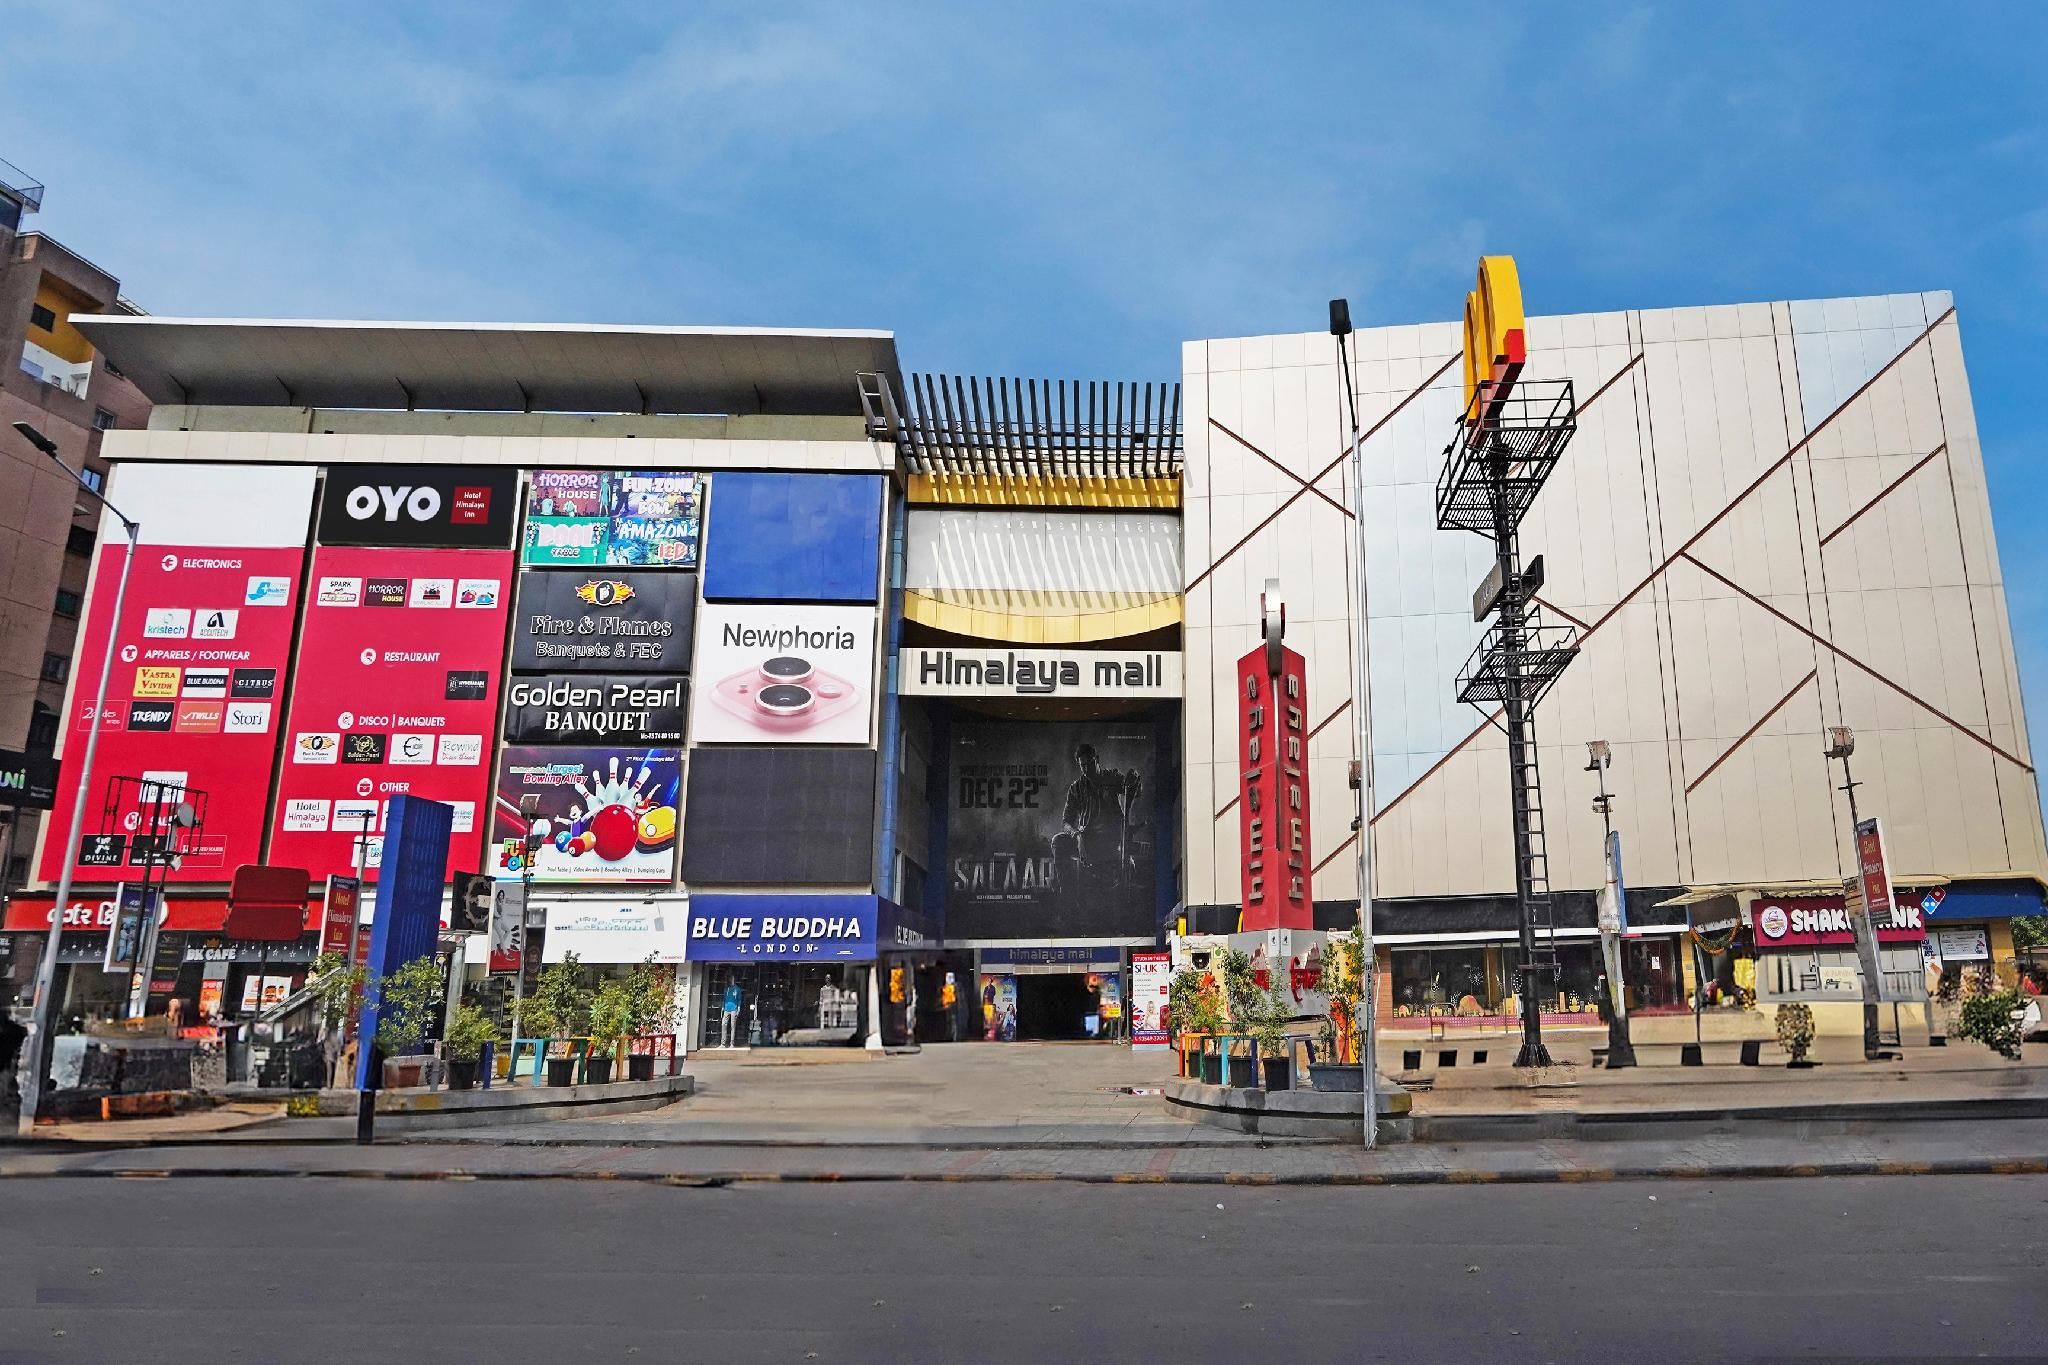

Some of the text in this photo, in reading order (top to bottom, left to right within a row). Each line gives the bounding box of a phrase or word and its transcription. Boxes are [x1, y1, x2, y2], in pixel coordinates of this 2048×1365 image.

[539, 473, 598, 488] HORROR
[558, 490, 597, 499] HOUSE
[346, 485, 441, 522] OYO
[618, 523, 688, 539] AMAZON
[182, 558, 242, 569] ELECTRONICS
[368, 584, 404, 594] HORROR
[148, 625, 184, 634] kristech
[530, 615, 672, 636] Fire & Flames
[723, 622, 855, 653] Newphoria
[144, 650, 250, 660] APPARELS / FOOTWEAR
[384, 652, 440, 662] RESTAURANT
[536, 642, 662, 659] Banquets & FEC
[142, 669, 176, 678] VASTRA
[920, 651, 1162, 693] Himalaya mall
[186, 677, 201, 685] BLUE
[510, 682, 680, 707] Golden Pearl
[132, 711, 171, 722] TRENDY
[232, 710, 262, 726] Stori
[359, 716, 388, 725] DISCO
[398, 717, 445, 726] BANQUETS
[544, 712, 650, 735] BANQUET
[546, 763, 583, 775] Largest
[523, 774, 588, 786] Bowling Alley
[1284, 674, 1304, 899] himalaya
[380, 782, 409, 792] OTHER
[959, 778, 1002, 808] DEC
[1246, 674, 1264, 900] himalaya
[296, 802, 320, 811] Hotel
[288, 812, 326, 822] Himalaya
[954, 857, 1054, 892] SALAAR
[336, 892, 350, 906] Hotel
[1791, 908, 1851, 931] SHAK
[692, 917, 861, 939] BLUE BUDDHA
[206, 948, 236, 960] CAFE
[1009, 948, 1092, 960] himalaya mall
